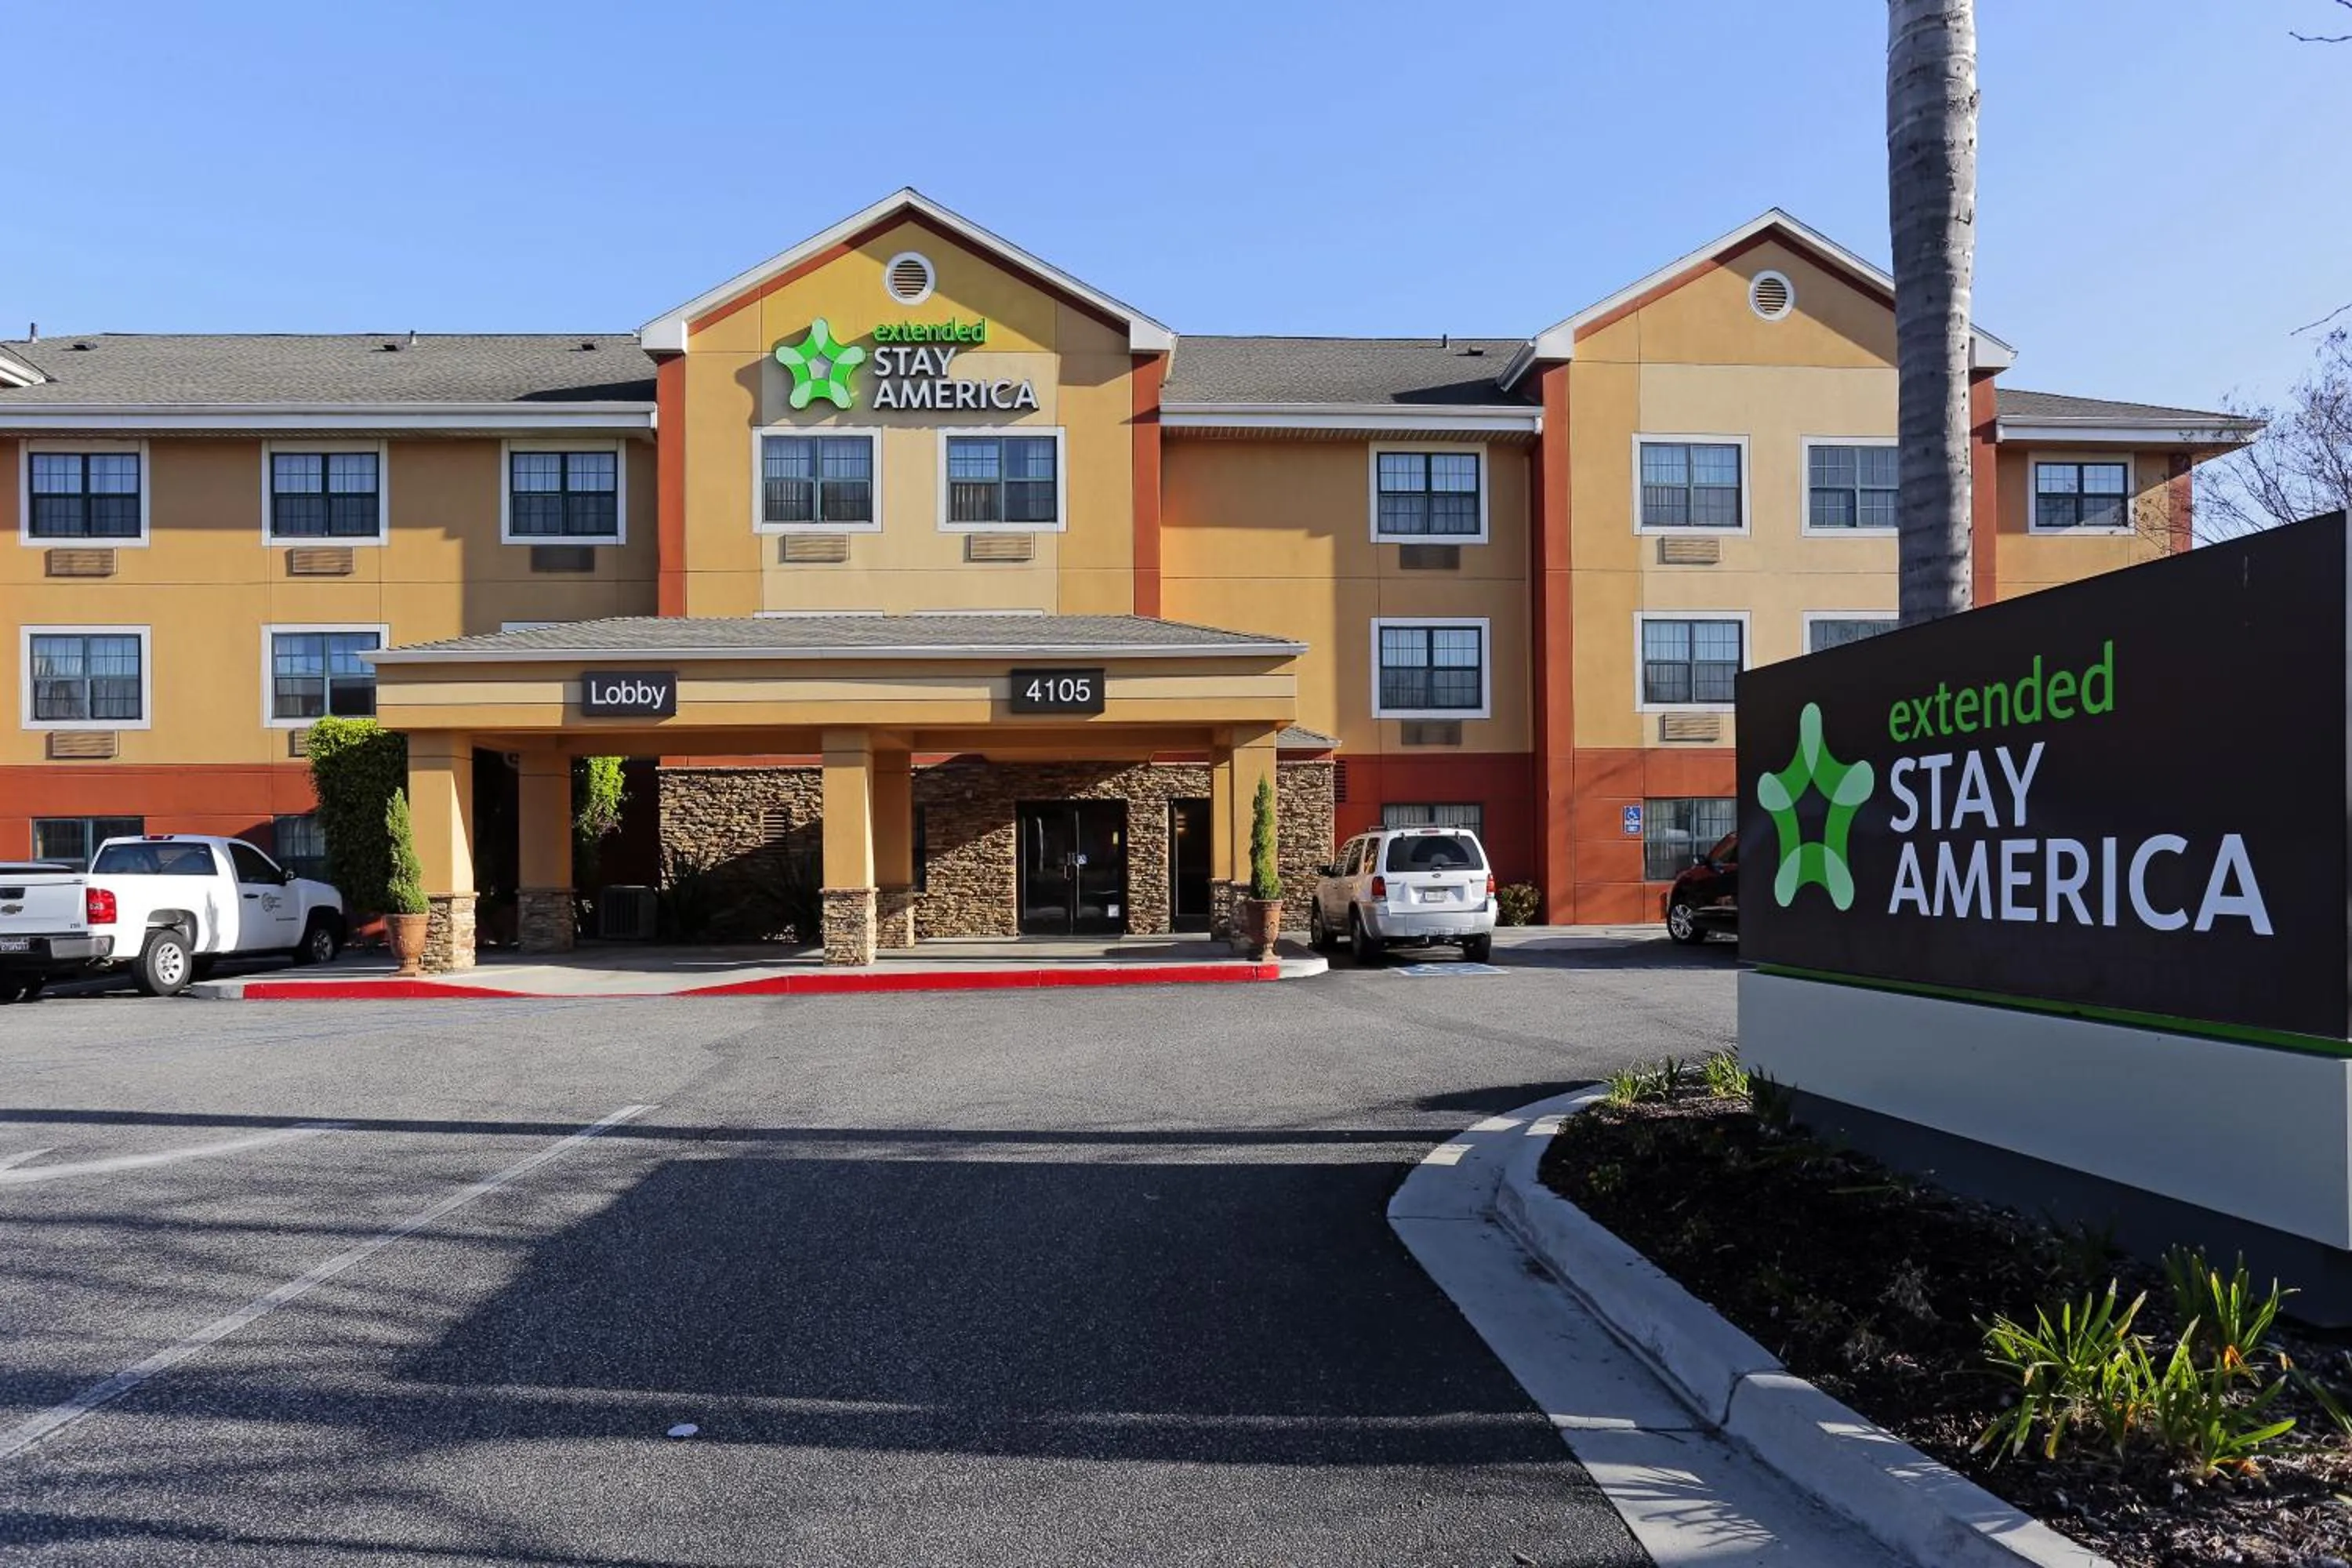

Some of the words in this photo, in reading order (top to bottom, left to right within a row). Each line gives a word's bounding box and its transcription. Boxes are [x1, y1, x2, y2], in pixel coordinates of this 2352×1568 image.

[873, 318, 986, 343] extended
[873, 347, 957, 377] STAY
[873, 379, 1040, 410] AMERICA
[591, 680, 667, 710] Lobby
[1025, 678, 1091, 702] 4105
[1888, 639, 2115, 742] extended
[1889, 742, 2045, 833] STAY
[1887, 833, 2274, 936] AMERICA
